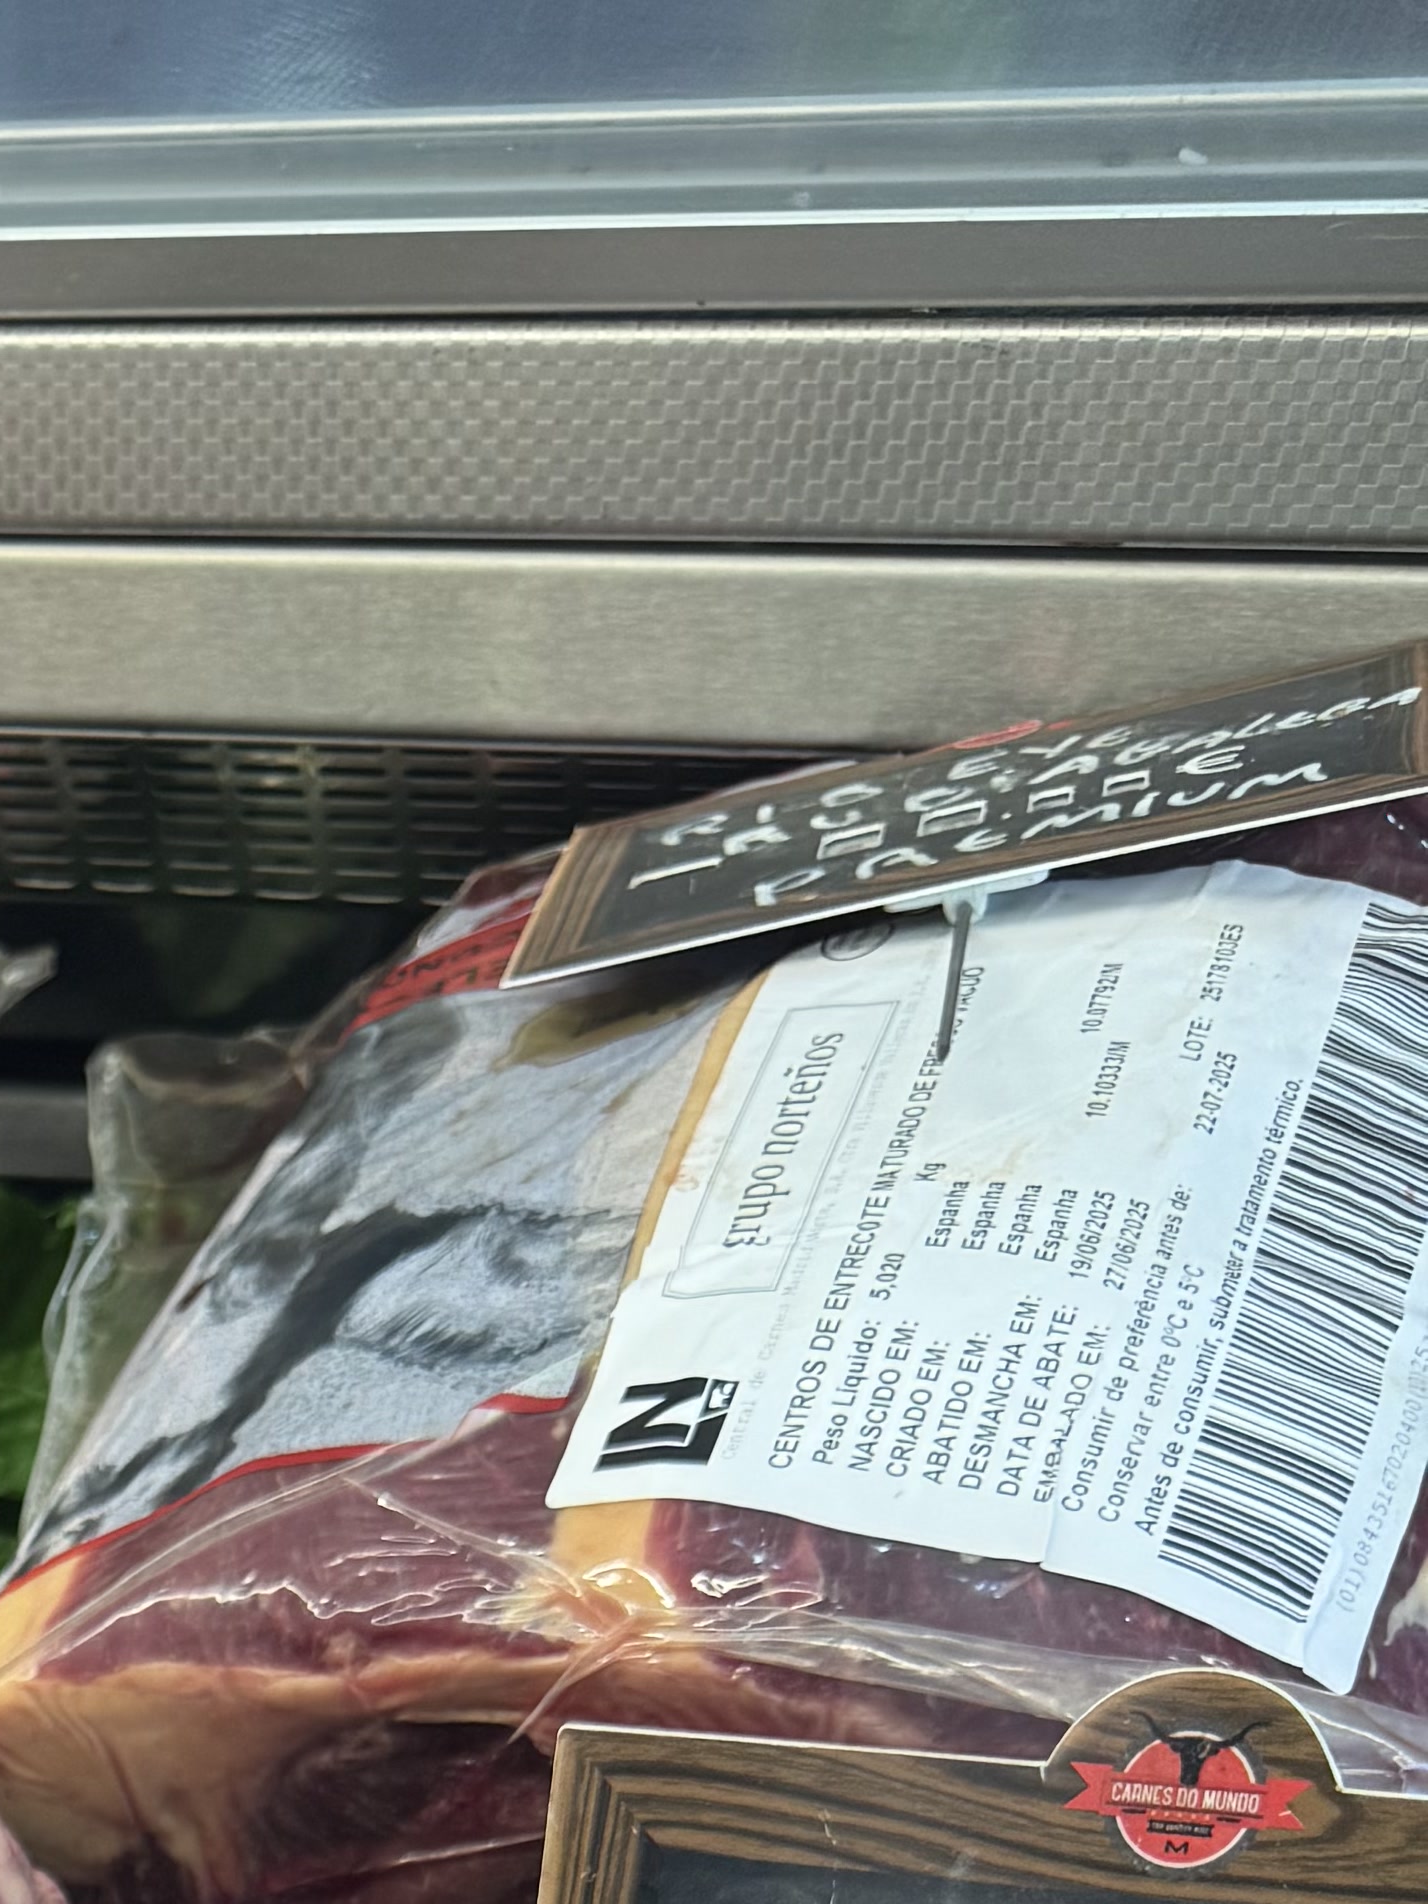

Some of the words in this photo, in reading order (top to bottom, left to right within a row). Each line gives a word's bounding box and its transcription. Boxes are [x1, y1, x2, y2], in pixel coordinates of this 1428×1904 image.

[1193, 1051, 1237, 1135] 22-07-2025
[1265, 1080, 1303, 1144] térmico.
[723, 1165, 791, 1248] grupo
[762, 1033, 844, 1155] norteños
[1069, 1191, 1115, 1277] 19/06/2025
[1169, 1185, 1191, 1211] de:
[1235, 1148, 1277, 1236] tratamento
[768, 1360, 827, 1468] CENTROS
[809, 1318, 841, 1351] DE
[871, 1107, 927, 1191] MATURADO
[909, 1080, 937, 1101] DE
[1033, 1374, 1093, 1502] EMBALADO
[1077, 1326, 1110, 1365] EM:
[1103, 1199, 1150, 1290] 27/06/2025
[1179, 1017, 1213, 1061] LOTE:
[1156, 1214, 1183, 1260] antes
[1233, 1239, 1248, 1251] a
[812, 1414, 848, 1464] Peso
[869, 1253, 905, 1300] 5,020
[914, 1163, 947, 1181] Kg
[848, 1369, 901, 1471] NASCIDO
[885, 1321, 918, 1361] EM:
[925, 1181, 970, 1247] Espanha
[886, 1389, 932, 1477] CRIADO
[917, 1341, 950, 1381] EM:
[961, 1182, 1006, 1250] Espanha
[1119, 1264, 1168, 1372] preferência
[1210, 1251, 1243, 1330] submeter
[923, 1381, 973, 1484] ABATIDO
[958, 1333, 991, 1373] EM:
[998, 1185, 1042, 1255] Espanha
[958, 1344, 1026, 1489] DESMANCHA
[1009, 1295, 1041, 1334] EM:
[1034, 1190, 1078, 1262] Espanha
[1032, 1305, 1078, 1390] ABATE:
[1018, 1396, 1048, 1427] DE
[1098, 1411, 1153, 1522] Conservar
[1144, 1354, 1175, 1407] entre
[1177, 1300, 1193, 1310] e
[1104, 1377, 1128, 1401] de
[1174, 1338, 1223, 1434] consumir,
[996, 1436, 1036, 1496] DATA
[1061, 1407, 1115, 1511] Consumir
[1161, 1442, 1183, 1467] de
[1135, 1475, 1171, 1536] Antes
[1176, 1789, 1198, 1808] DO
[1201, 1789, 1260, 1814] MUNDO
